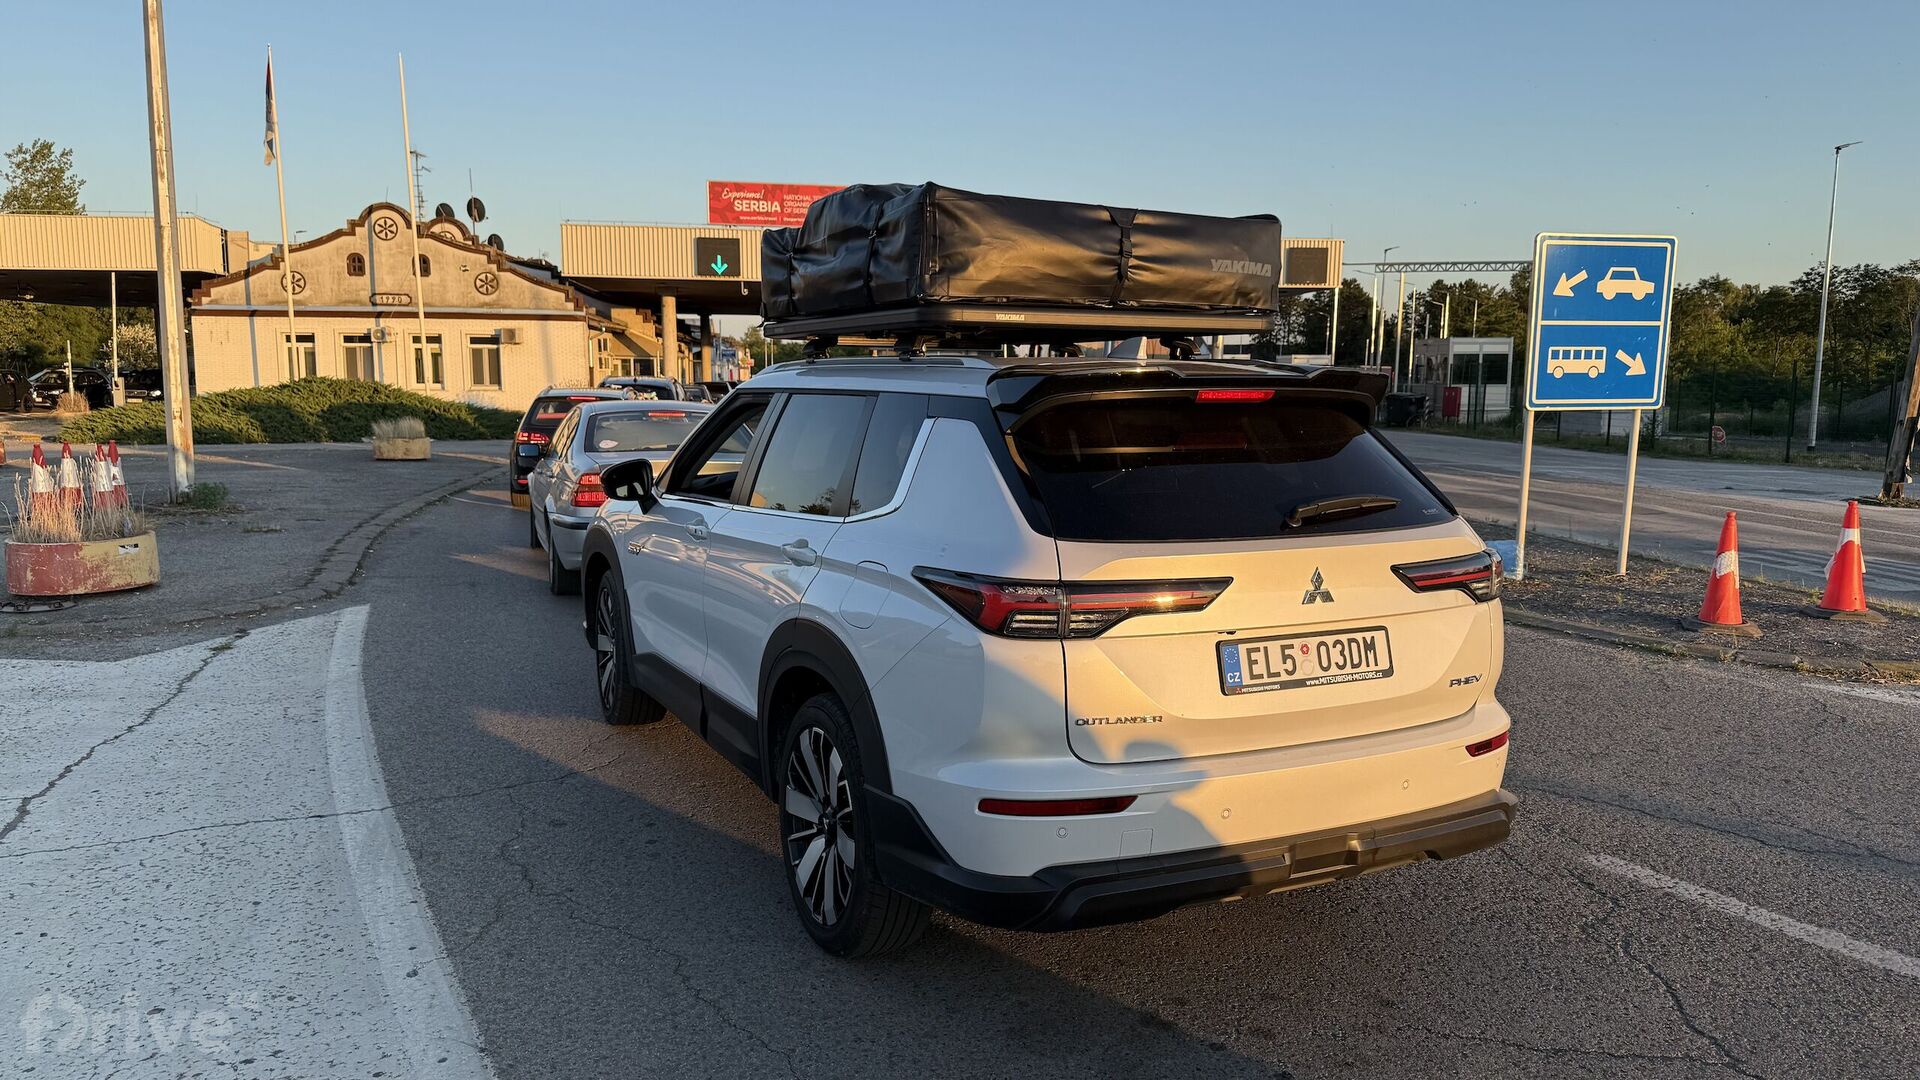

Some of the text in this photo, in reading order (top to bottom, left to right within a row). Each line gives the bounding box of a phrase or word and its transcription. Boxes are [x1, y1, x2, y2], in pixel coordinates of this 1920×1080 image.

[722, 188, 764, 202] Experience!
[734, 200, 781, 213] SERBIA
[1210, 258, 1272, 277] YAKIMA
[995, 313, 1025, 321] YAKIMA
[1245, 636, 1379, 681] EL5 03DM
[1227, 672, 1241, 683] CZ
[1305, 671, 1383, 686] www.MITSUBISHI-MOTORS.cz
[1449, 673, 1482, 688] PHEV
[1074, 715, 1163, 726] OUTLANDER
